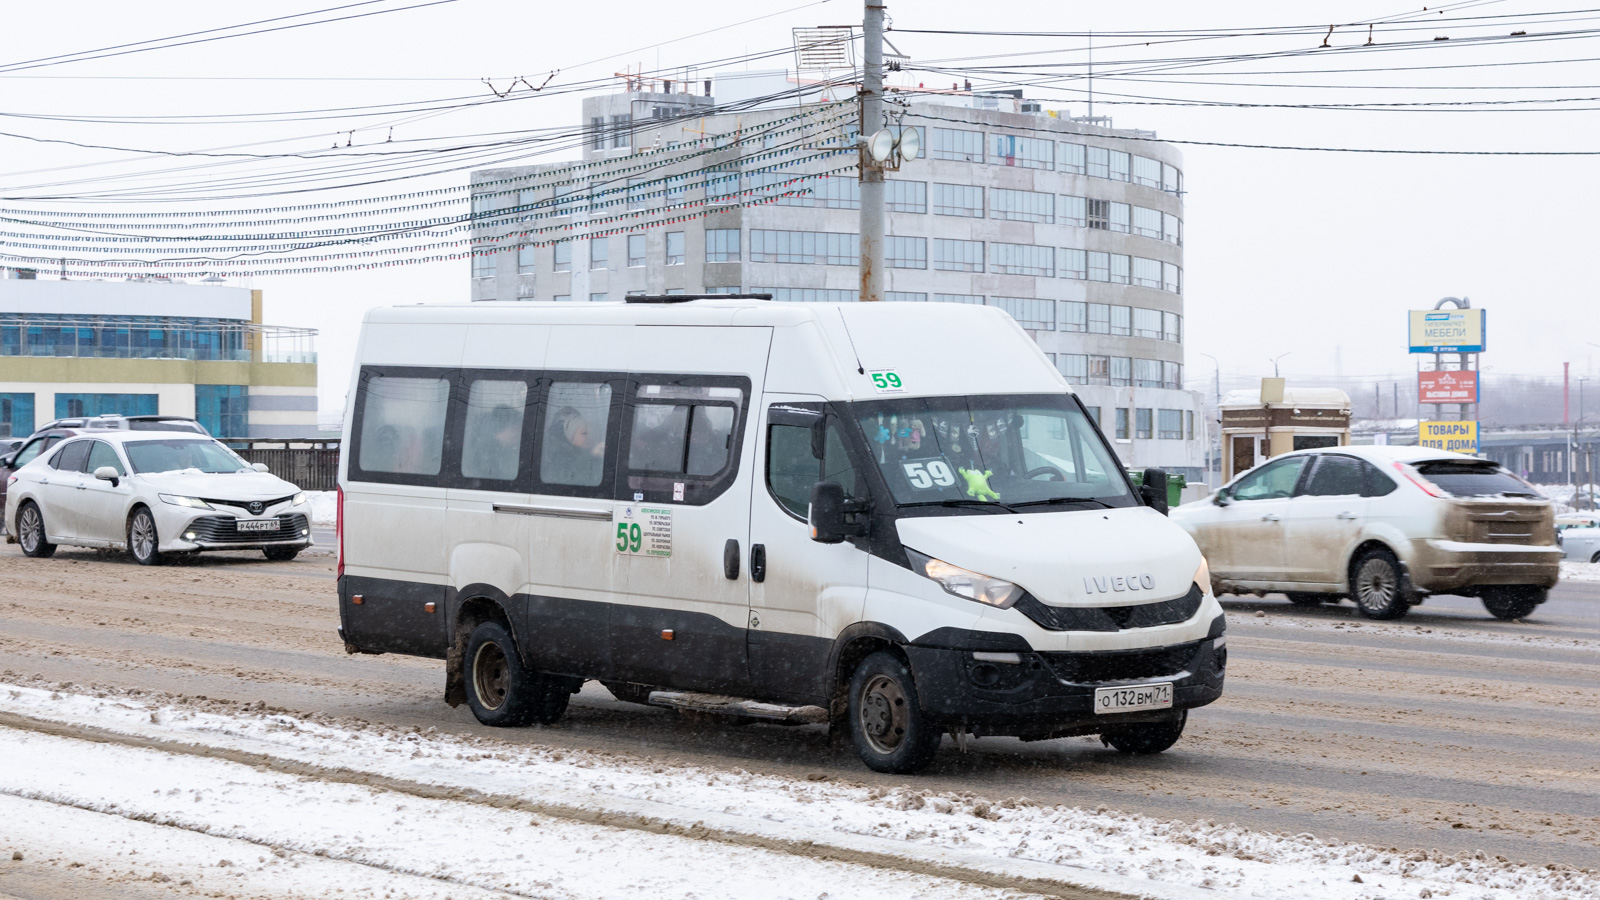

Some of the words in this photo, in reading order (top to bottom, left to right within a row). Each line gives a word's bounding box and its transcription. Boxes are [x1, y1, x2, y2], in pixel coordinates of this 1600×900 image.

[1425, 328, 1466, 337] МЕБЕЛИ
[871, 372, 902, 388] 59
[1427, 424, 1469, 435] ТОВАРЫ
[1422, 440, 1443, 450] ДЛЯ
[1446, 440, 1478, 452] ДОМА
[903, 460, 955, 489] 59
[616, 522, 642, 552] 59
[1083, 573, 1156, 594] IVECO
[1156, 686, 1167, 698] 71
